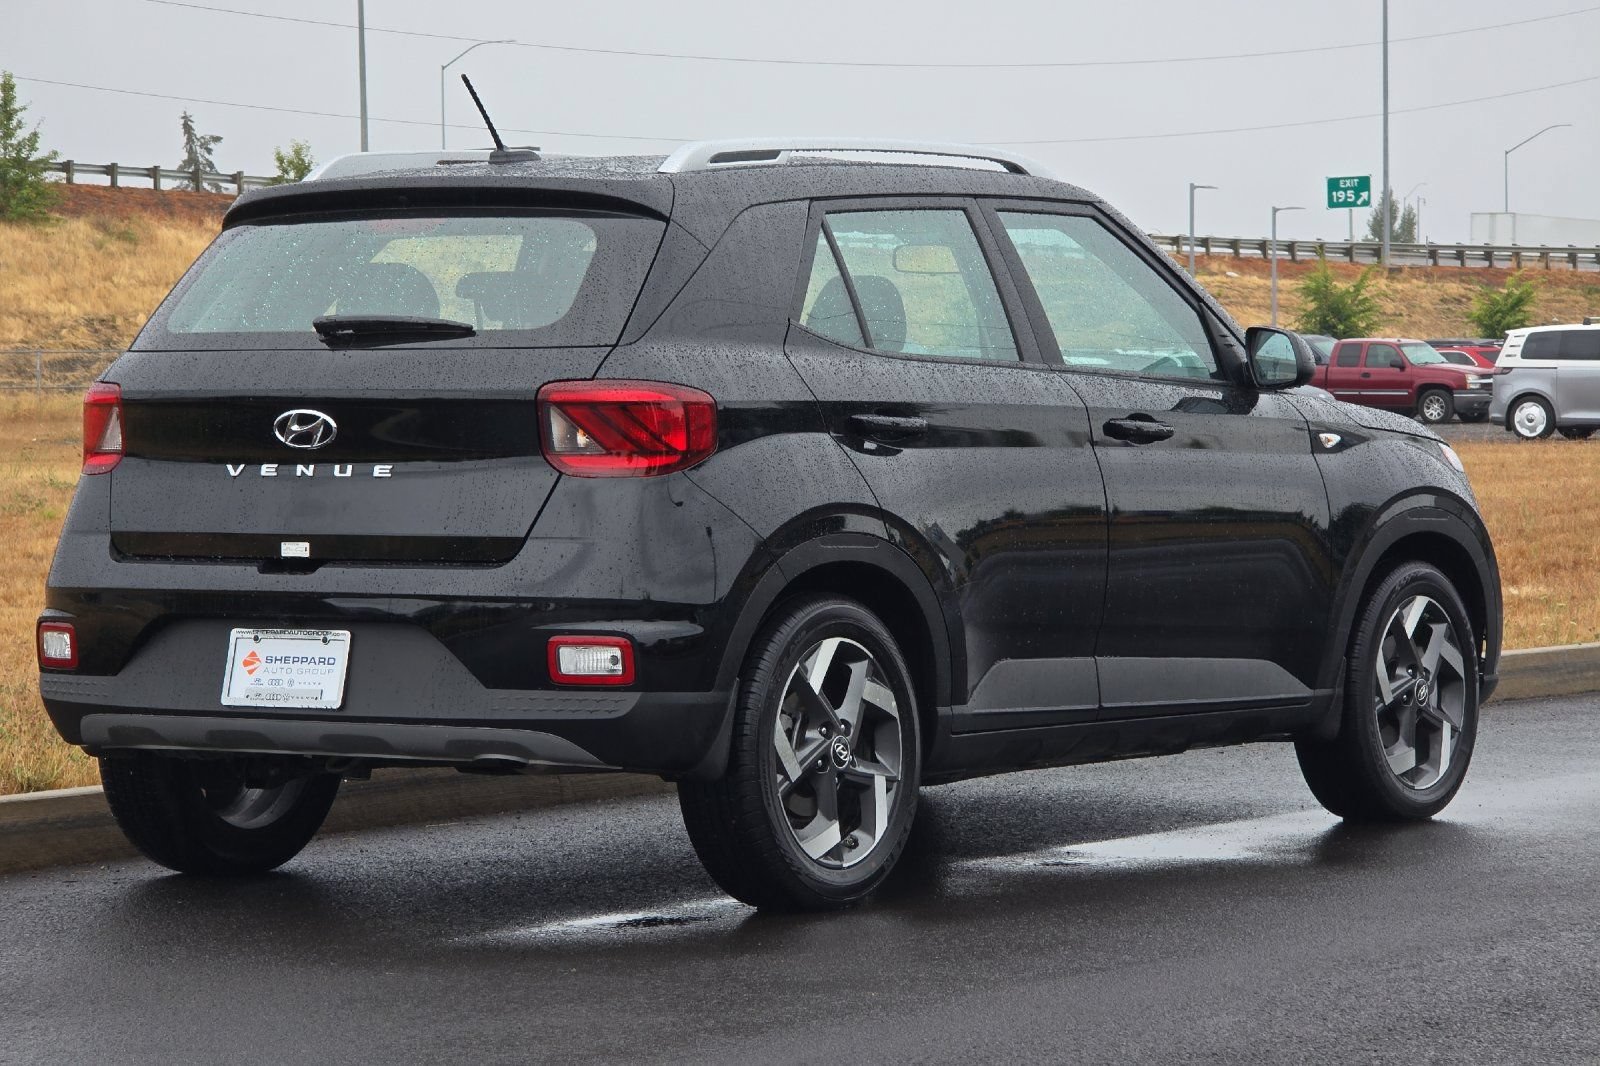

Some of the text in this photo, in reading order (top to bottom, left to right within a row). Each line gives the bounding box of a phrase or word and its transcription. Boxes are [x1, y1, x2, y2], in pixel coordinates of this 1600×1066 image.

[1339, 179, 1359, 187] EXIT
[1332, 190, 1355, 202] 195
[226, 463, 393, 477] VENUE
[265, 655, 336, 666] SHEPPARD
